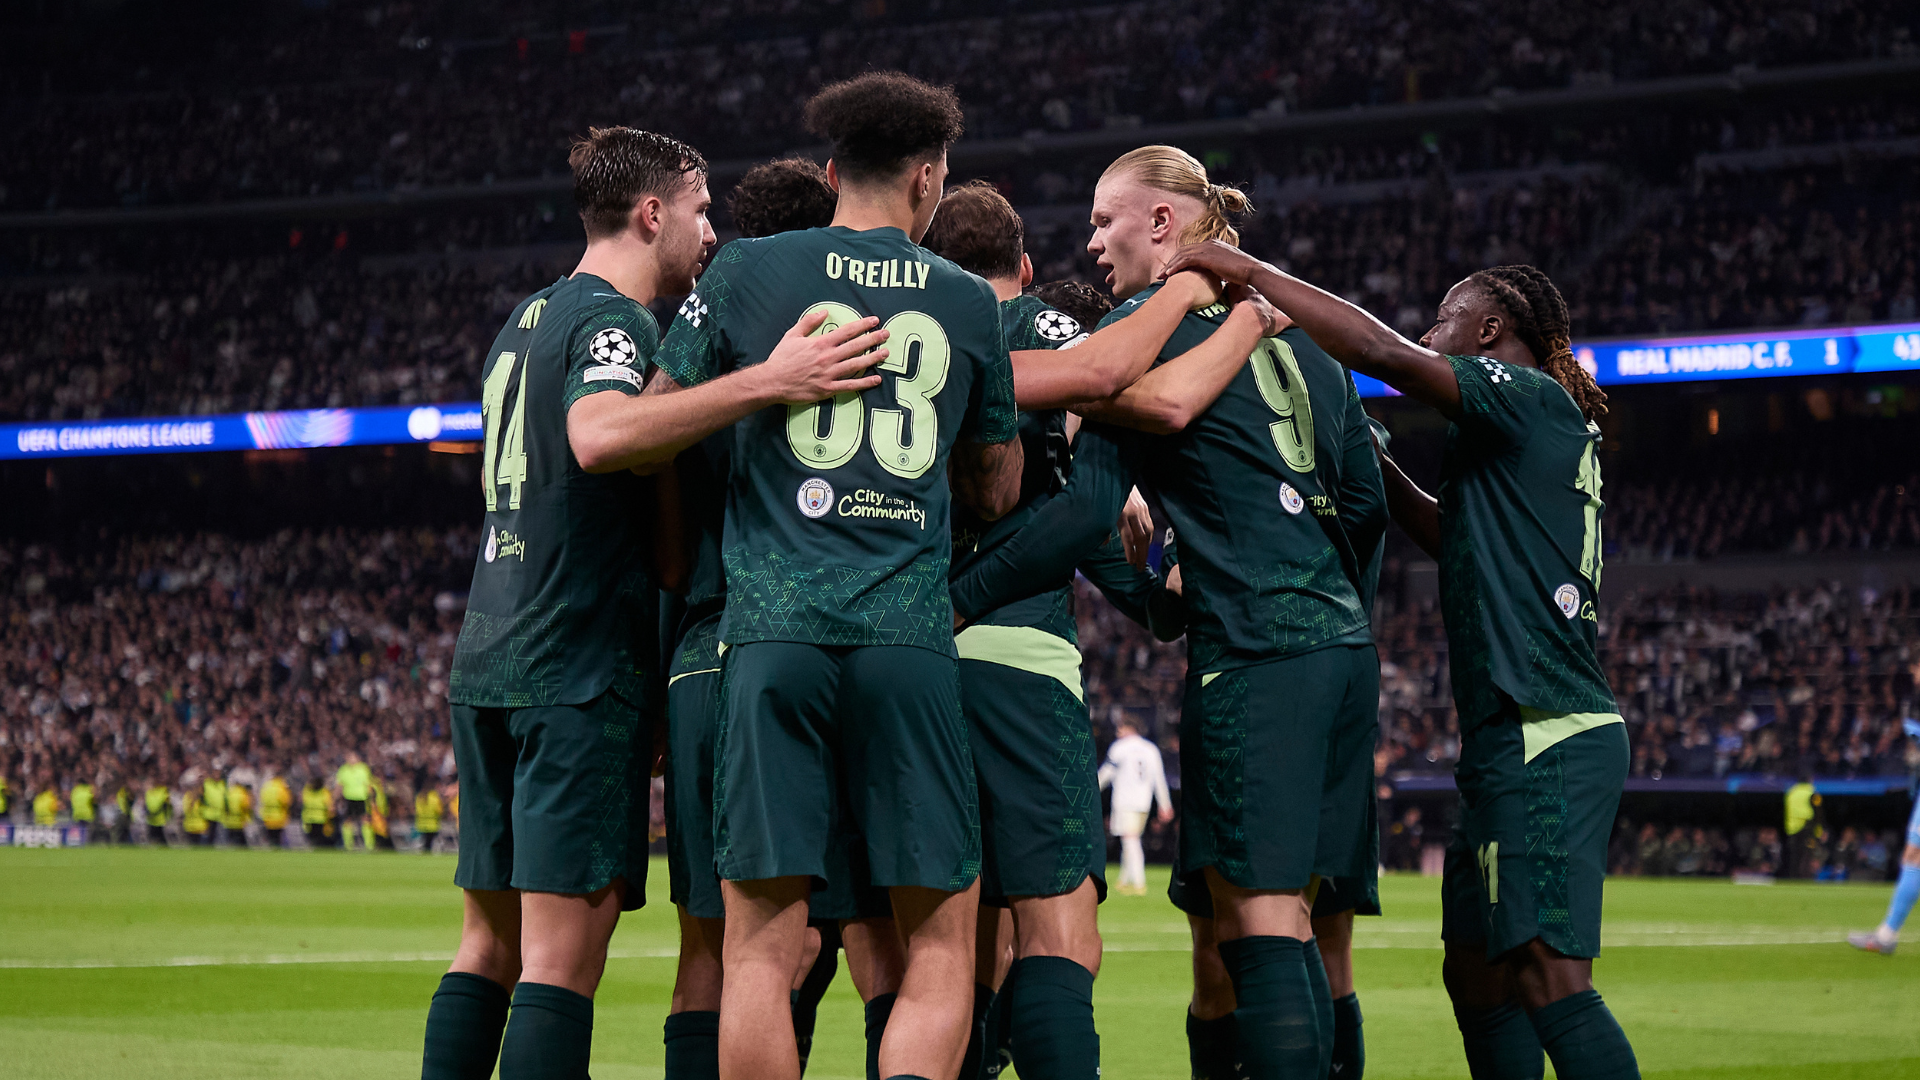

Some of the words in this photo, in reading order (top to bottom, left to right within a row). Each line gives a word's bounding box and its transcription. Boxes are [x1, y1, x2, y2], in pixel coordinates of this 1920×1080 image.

[1617, 349, 1669, 376] REAL
[1669, 343, 1752, 374] MADRID
[1823, 338, 1841, 367] 1
[1248, 337, 1316, 474] 9
[18, 428, 59, 452] UEFA
[58, 423, 151, 450] CHAMPIONS
[151, 420, 215, 447] LEAGUE
[482, 348, 530, 512] 14
[801, 480, 831, 494] MANCHESTER
[854, 489, 885, 506] City
[885, 496, 893, 505] in
[893, 497, 905, 507] the
[837, 494, 926, 531] Community
